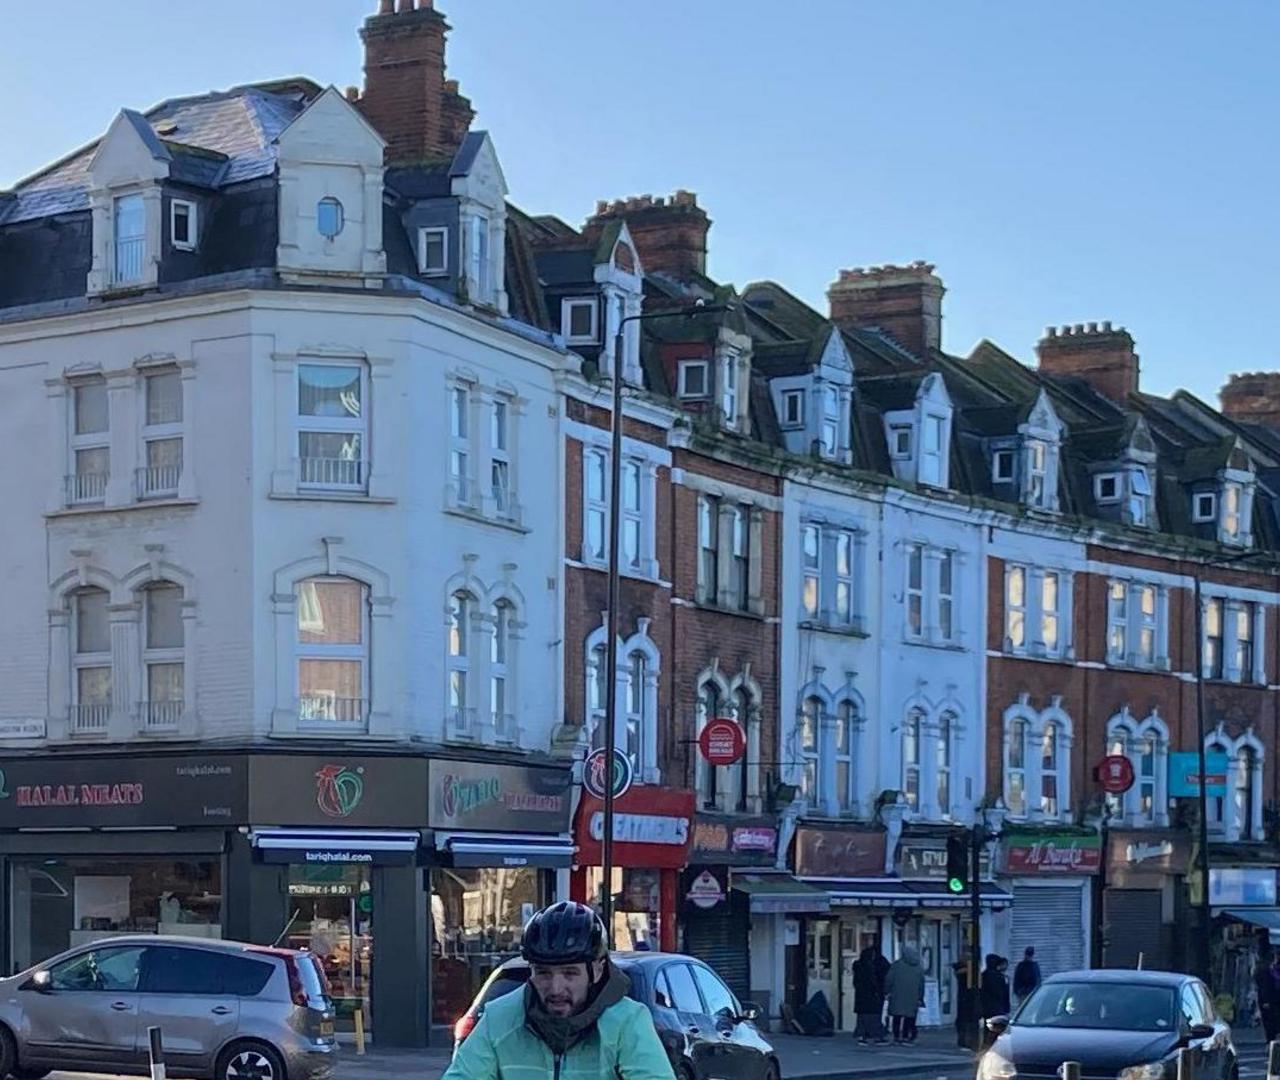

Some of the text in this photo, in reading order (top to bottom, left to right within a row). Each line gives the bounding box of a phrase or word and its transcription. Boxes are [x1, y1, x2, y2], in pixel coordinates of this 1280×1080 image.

[16, 784, 80, 807] HALAL
[80, 783, 144, 805] MEATS
[305, 851, 373, 862] tariqhalal.com
